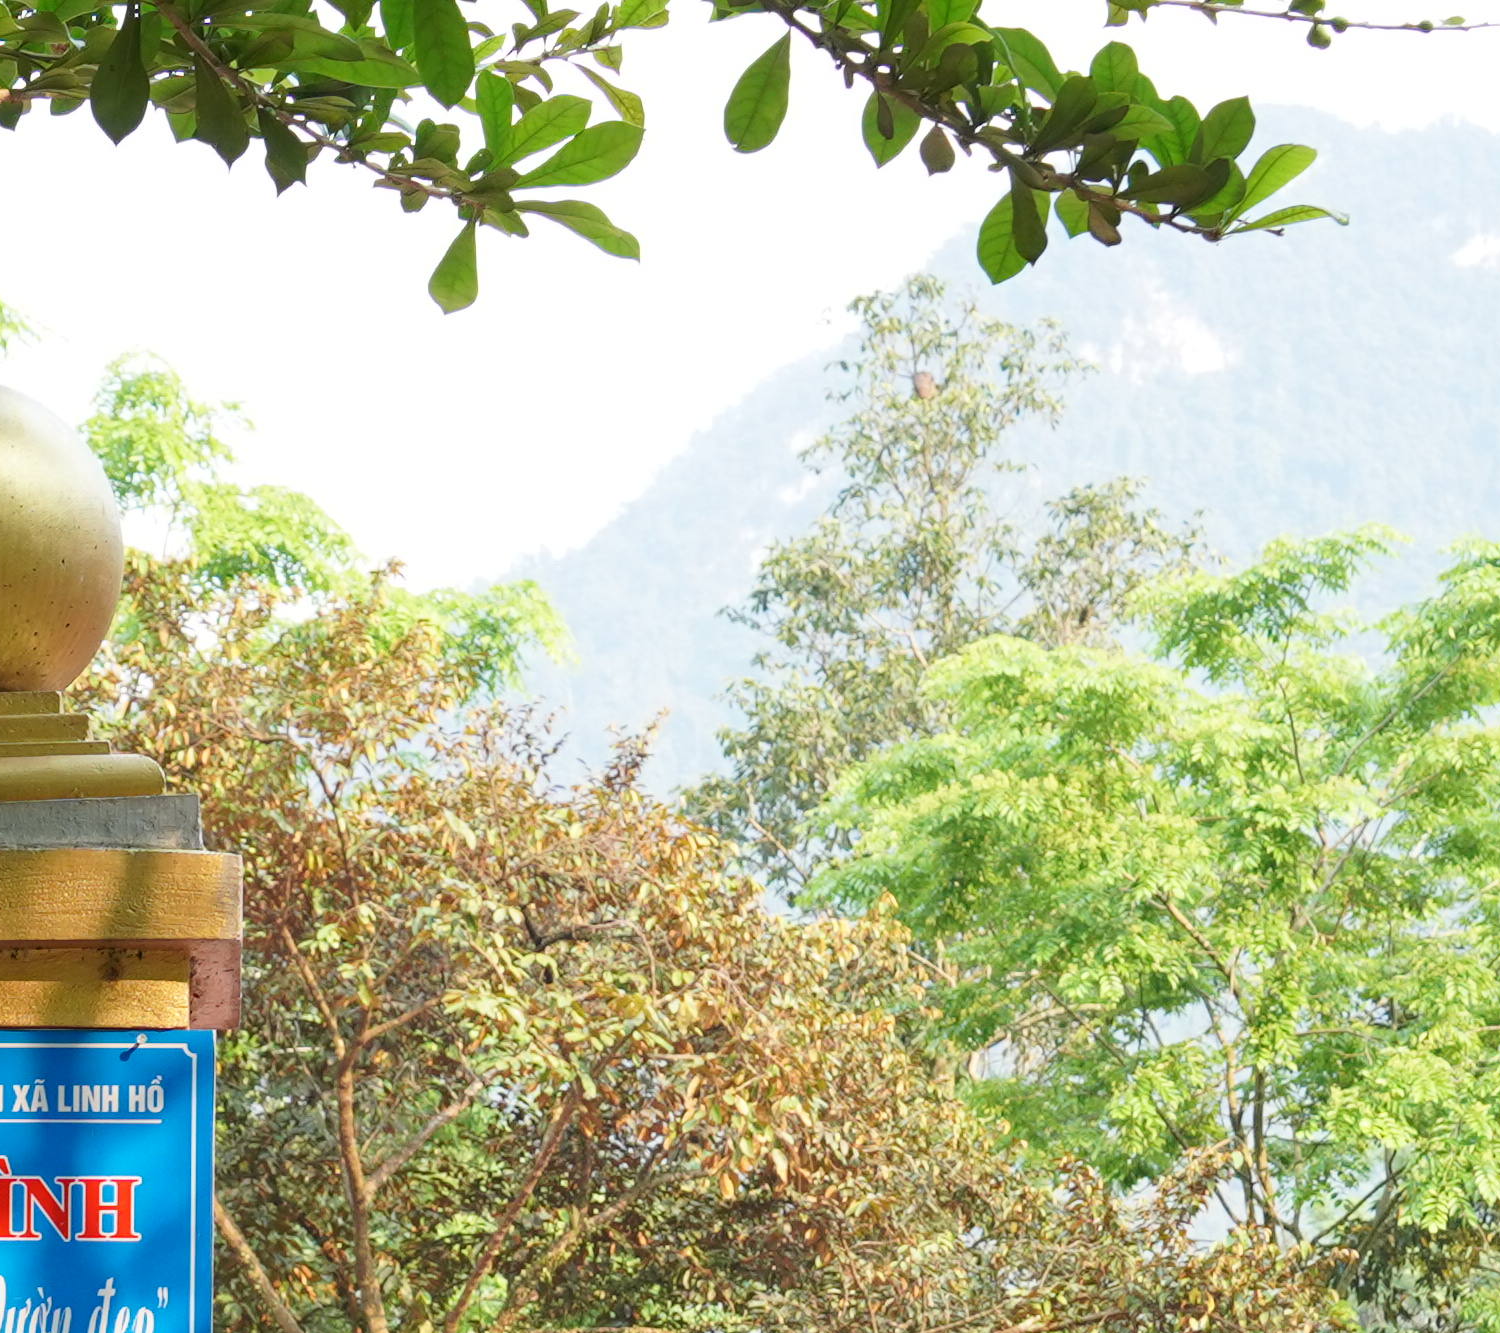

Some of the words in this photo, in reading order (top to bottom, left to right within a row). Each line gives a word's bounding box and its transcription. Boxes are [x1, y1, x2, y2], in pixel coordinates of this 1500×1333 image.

[12, 1077, 46, 1113] XÃ
[57, 1084, 115, 1114] LINH
[128, 1074, 165, 1114] HỒ
